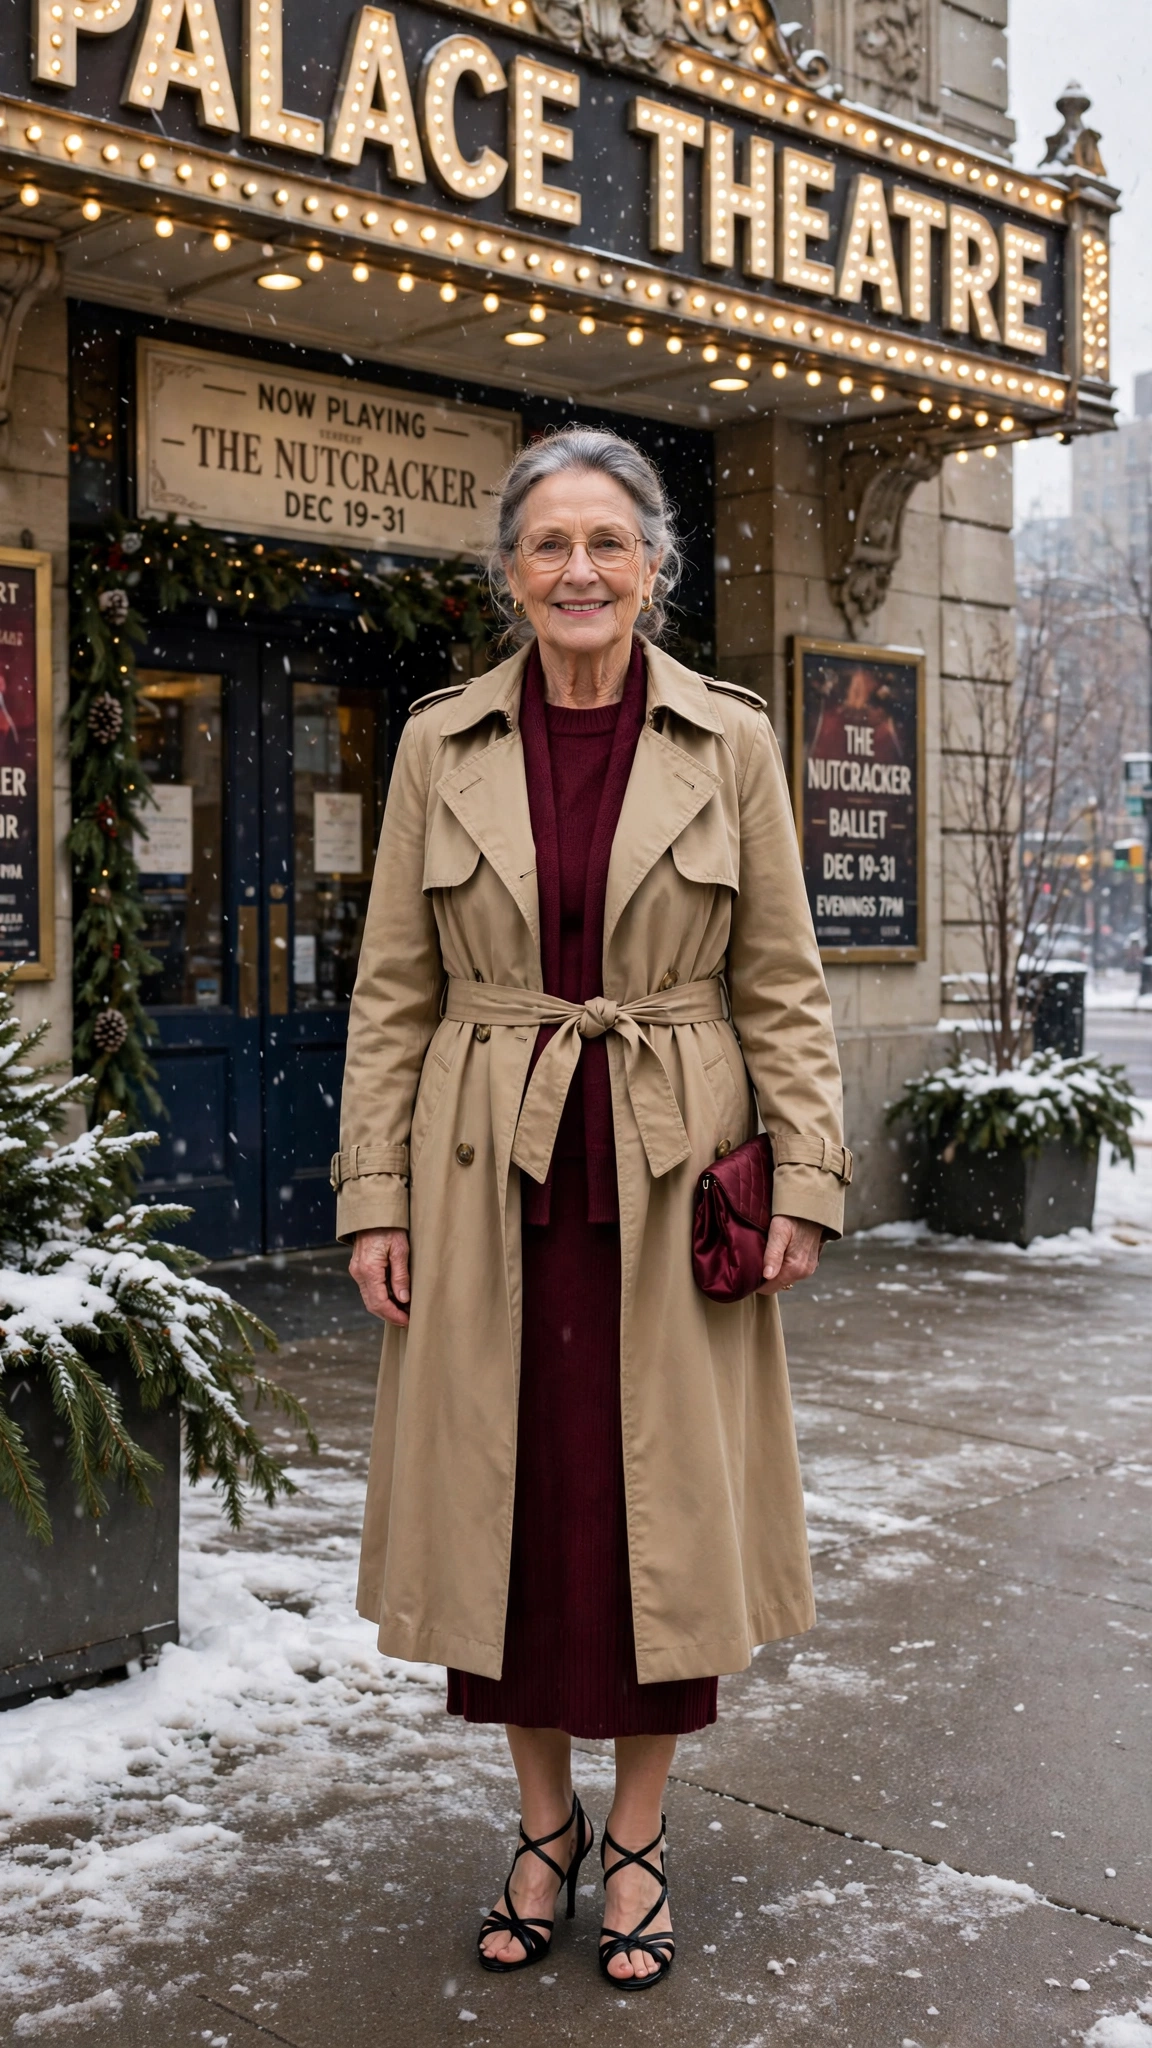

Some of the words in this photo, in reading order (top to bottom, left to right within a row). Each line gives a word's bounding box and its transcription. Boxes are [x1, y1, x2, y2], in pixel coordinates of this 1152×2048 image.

[628, 96, 1047, 356] THEATRE
[257, 382, 316, 419] NOW
[326, 396, 426, 439] PLAYING
[192, 423, 263, 476] THE
[274, 437, 478, 509] NUTCRACKER
[284, 490, 333, 524] DEC
[344, 500, 405, 534] 19-31
[844, 724, 875, 756] THE
[807, 757, 912, 796] NUTCRACKER
[829, 807, 888, 840] BALLET
[823, 853, 854, 881] DEC
[858, 853, 896, 883] 19-31
[816, 895, 877, 918] EVENINGS
[879, 896, 904, 918] 7PM
